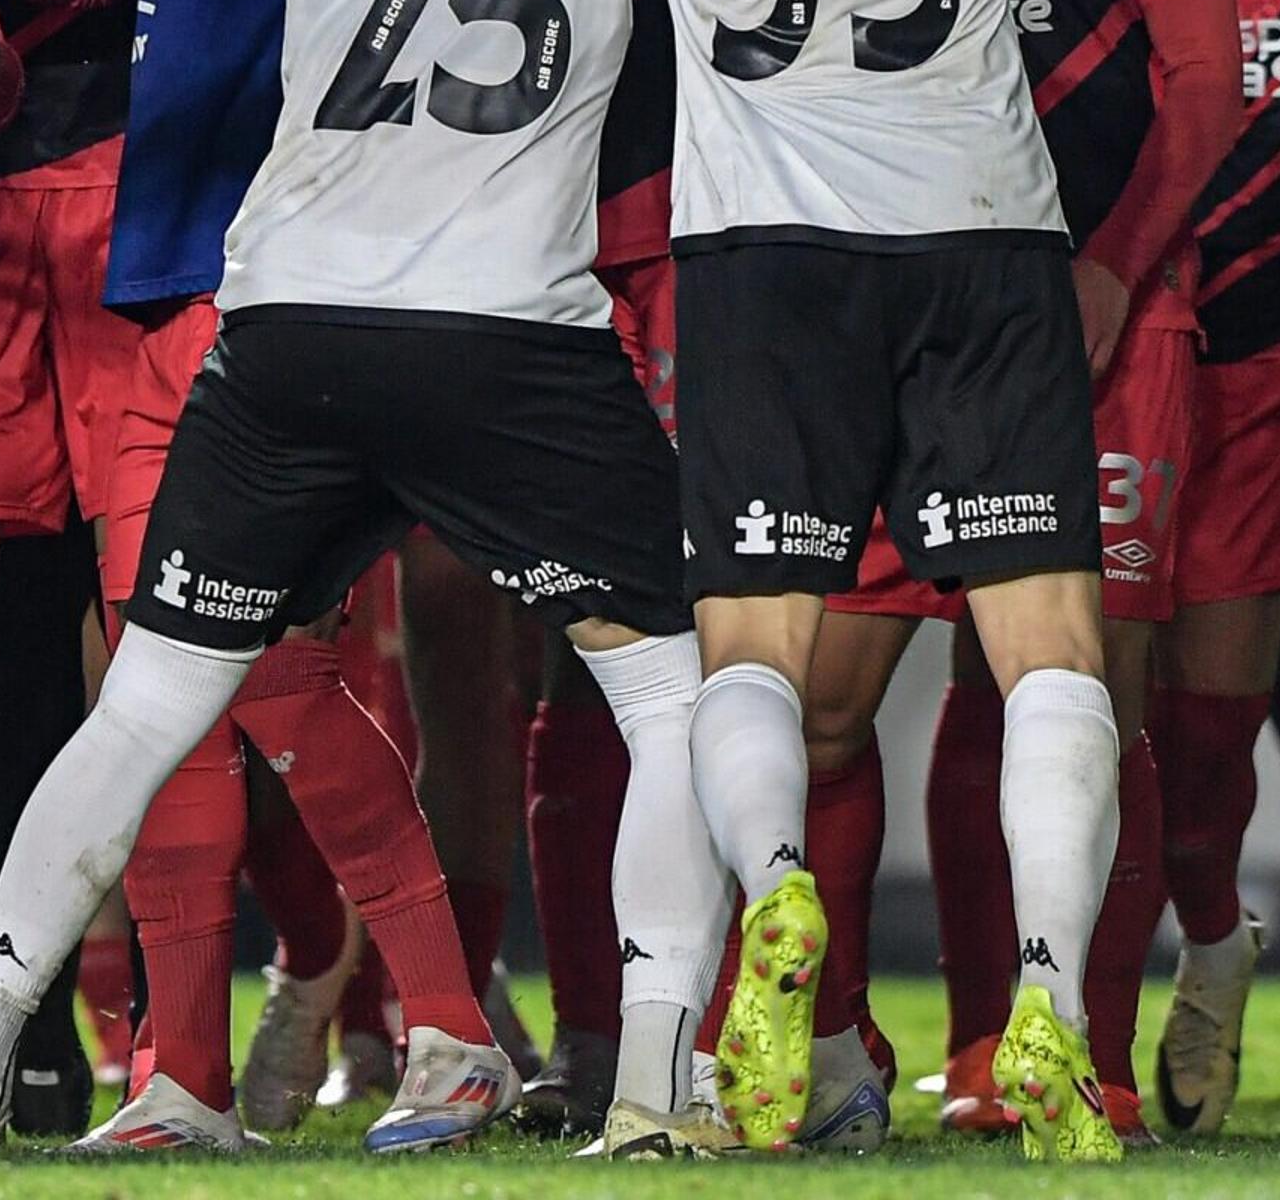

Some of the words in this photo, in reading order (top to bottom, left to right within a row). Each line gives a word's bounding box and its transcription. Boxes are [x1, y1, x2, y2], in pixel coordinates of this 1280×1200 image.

[540, 18, 561, 66] SCORE
[957, 493, 1056, 519] Intermac
[958, 514, 1058, 540] assistance
